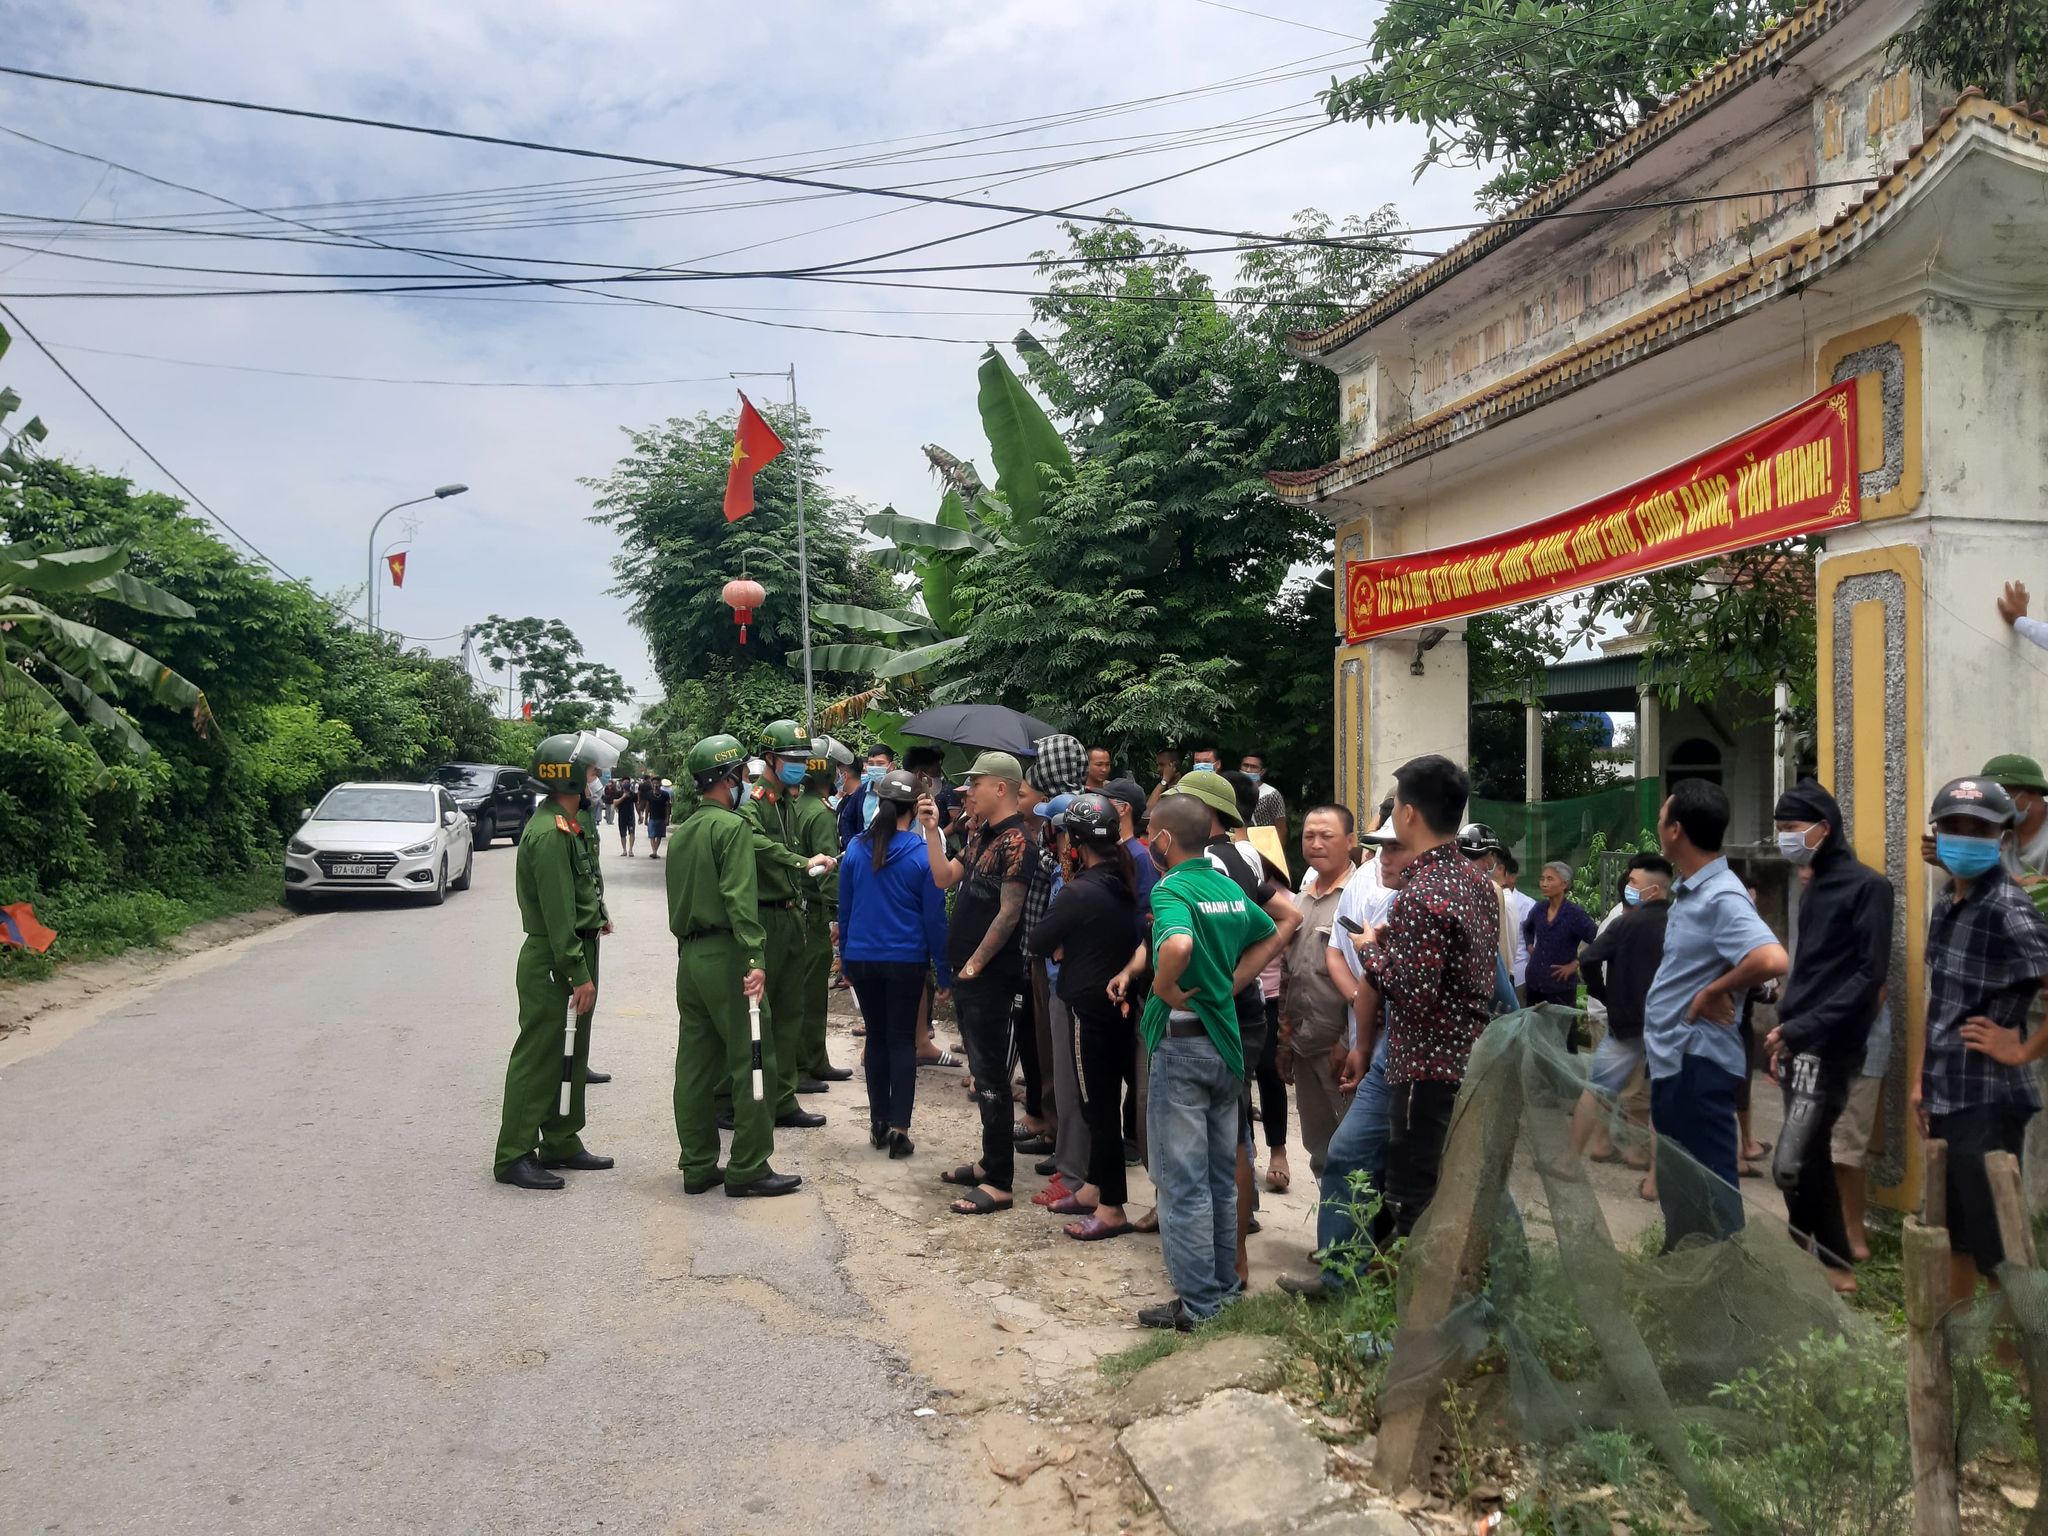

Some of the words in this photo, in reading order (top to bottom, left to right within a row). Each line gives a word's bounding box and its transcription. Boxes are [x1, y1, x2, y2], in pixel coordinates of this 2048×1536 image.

[1635, 490, 1685, 547] CÔNG
[1736, 452, 1772, 518] VĂN
[1776, 436, 1832, 508] MINH!
[714, 748, 739, 762] CSTT
[539, 763, 573, 778] CSTT
[1197, 900, 1230, 914] THANH
